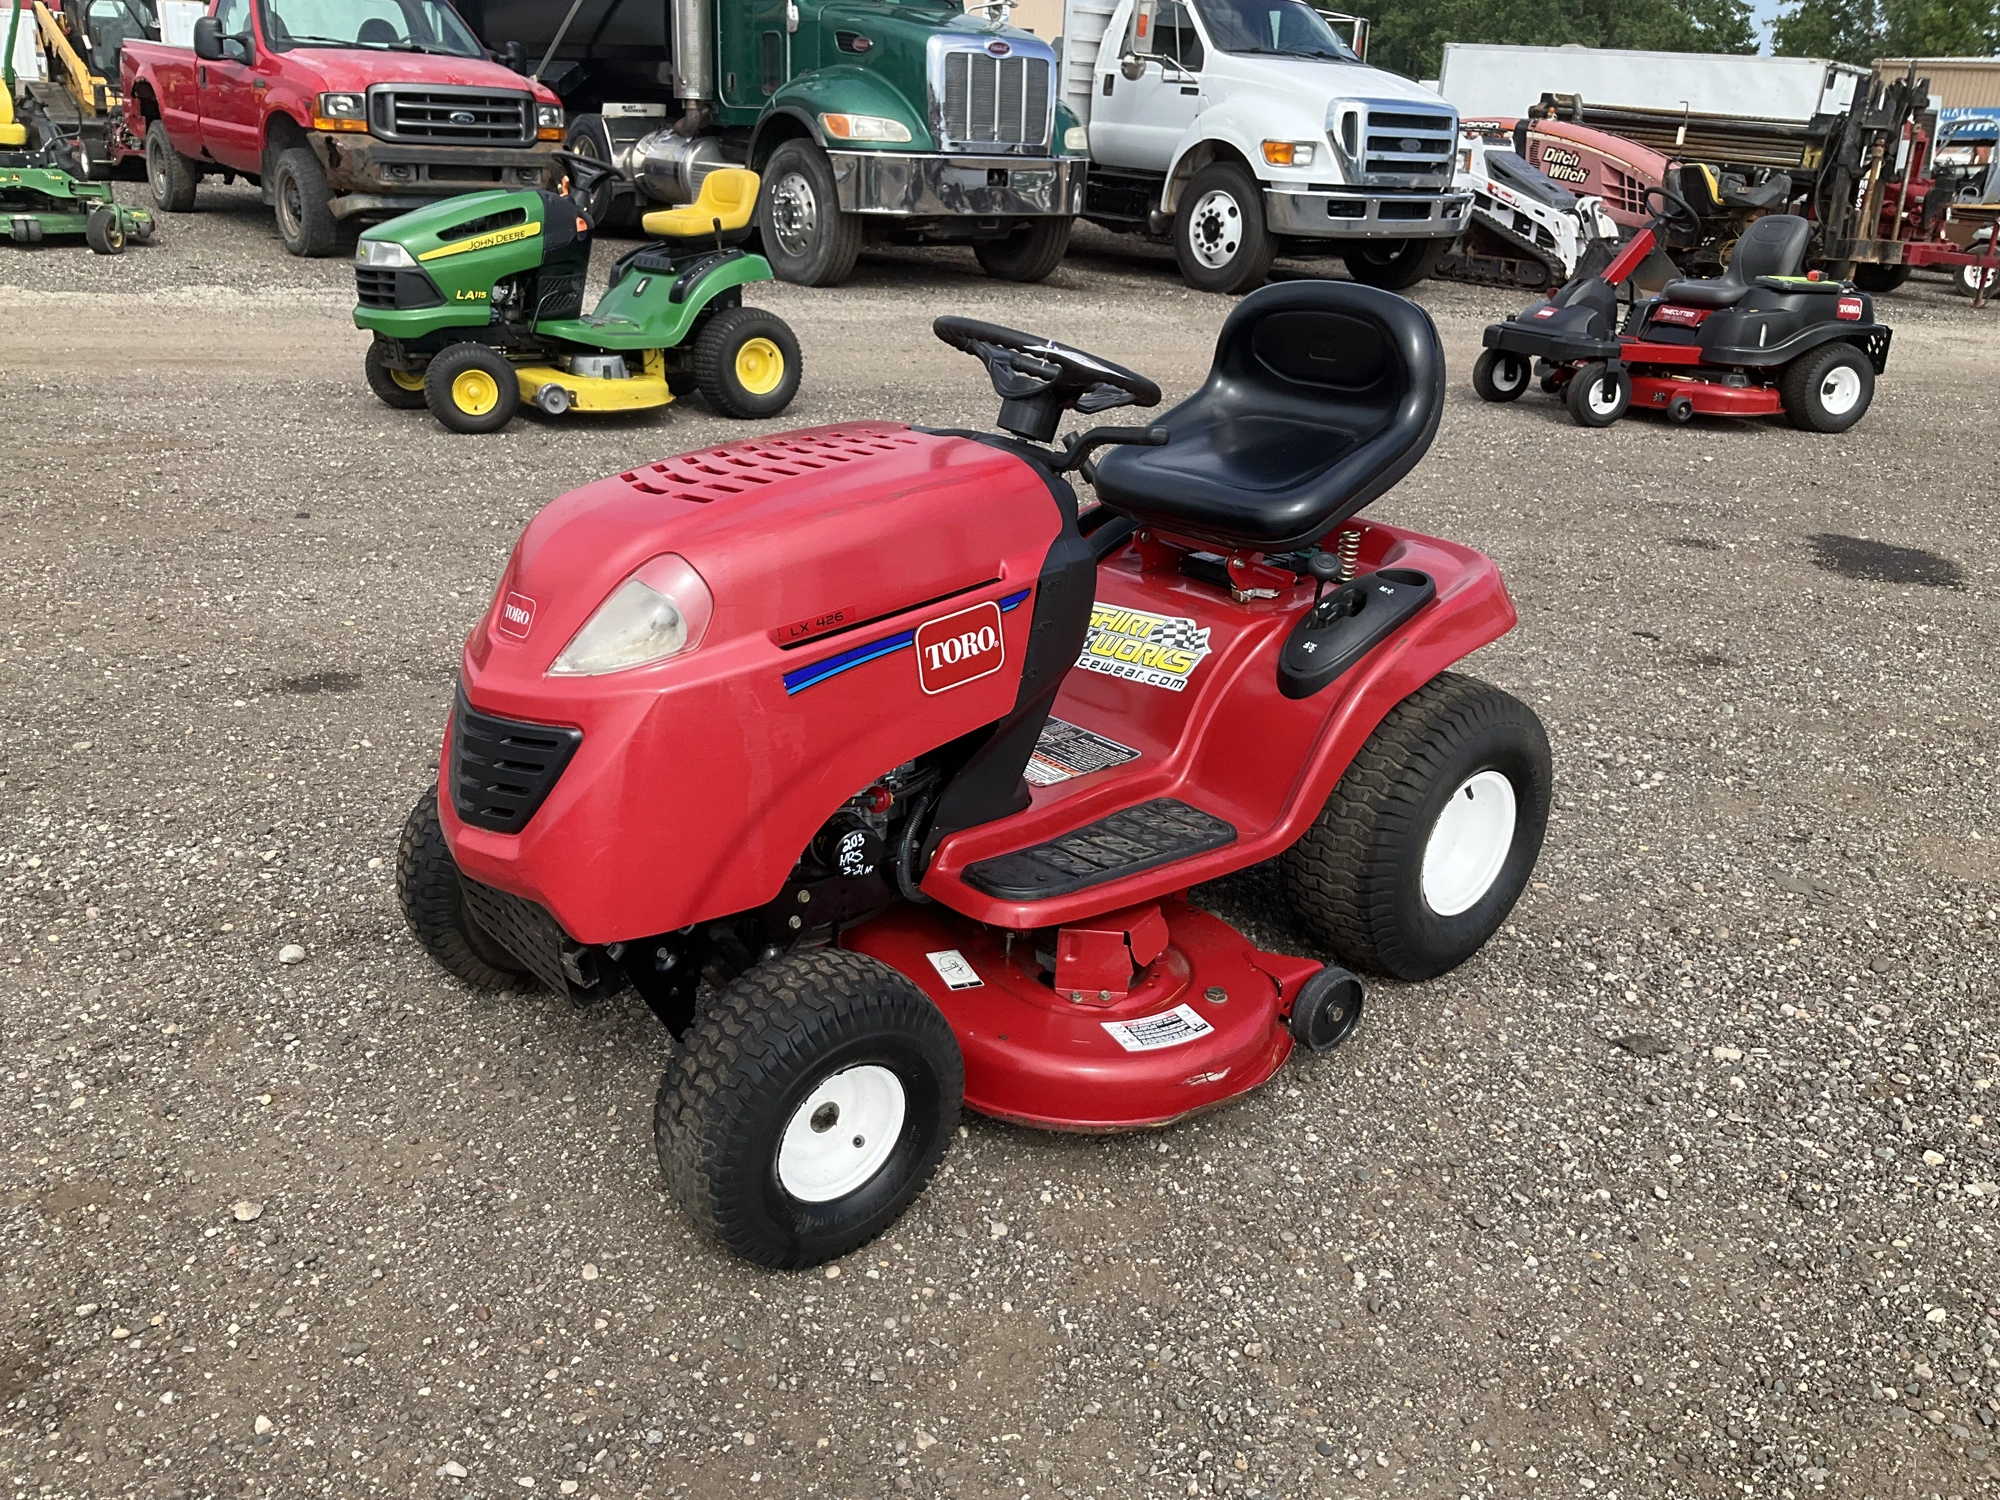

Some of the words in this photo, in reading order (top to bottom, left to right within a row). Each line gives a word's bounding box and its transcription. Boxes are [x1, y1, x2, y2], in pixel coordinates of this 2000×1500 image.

[1543, 147, 1581, 167] Ditch
[1549, 163, 1588, 184] Witch
[468, 237, 494, 251] JOHN
[496, 229, 526, 245] DEERE
[1839, 304, 1860, 314] TORO
[505, 603, 530, 625] TORO
[790, 622, 810, 637] LX
[815, 611, 844, 627] 426
[925, 625, 996, 671] TORO
[1090, 633, 1200, 675] WORKS
[1078, 656, 1186, 690] cewear.com
[842, 833, 865, 853] 203
[839, 849, 864, 866] HRS
